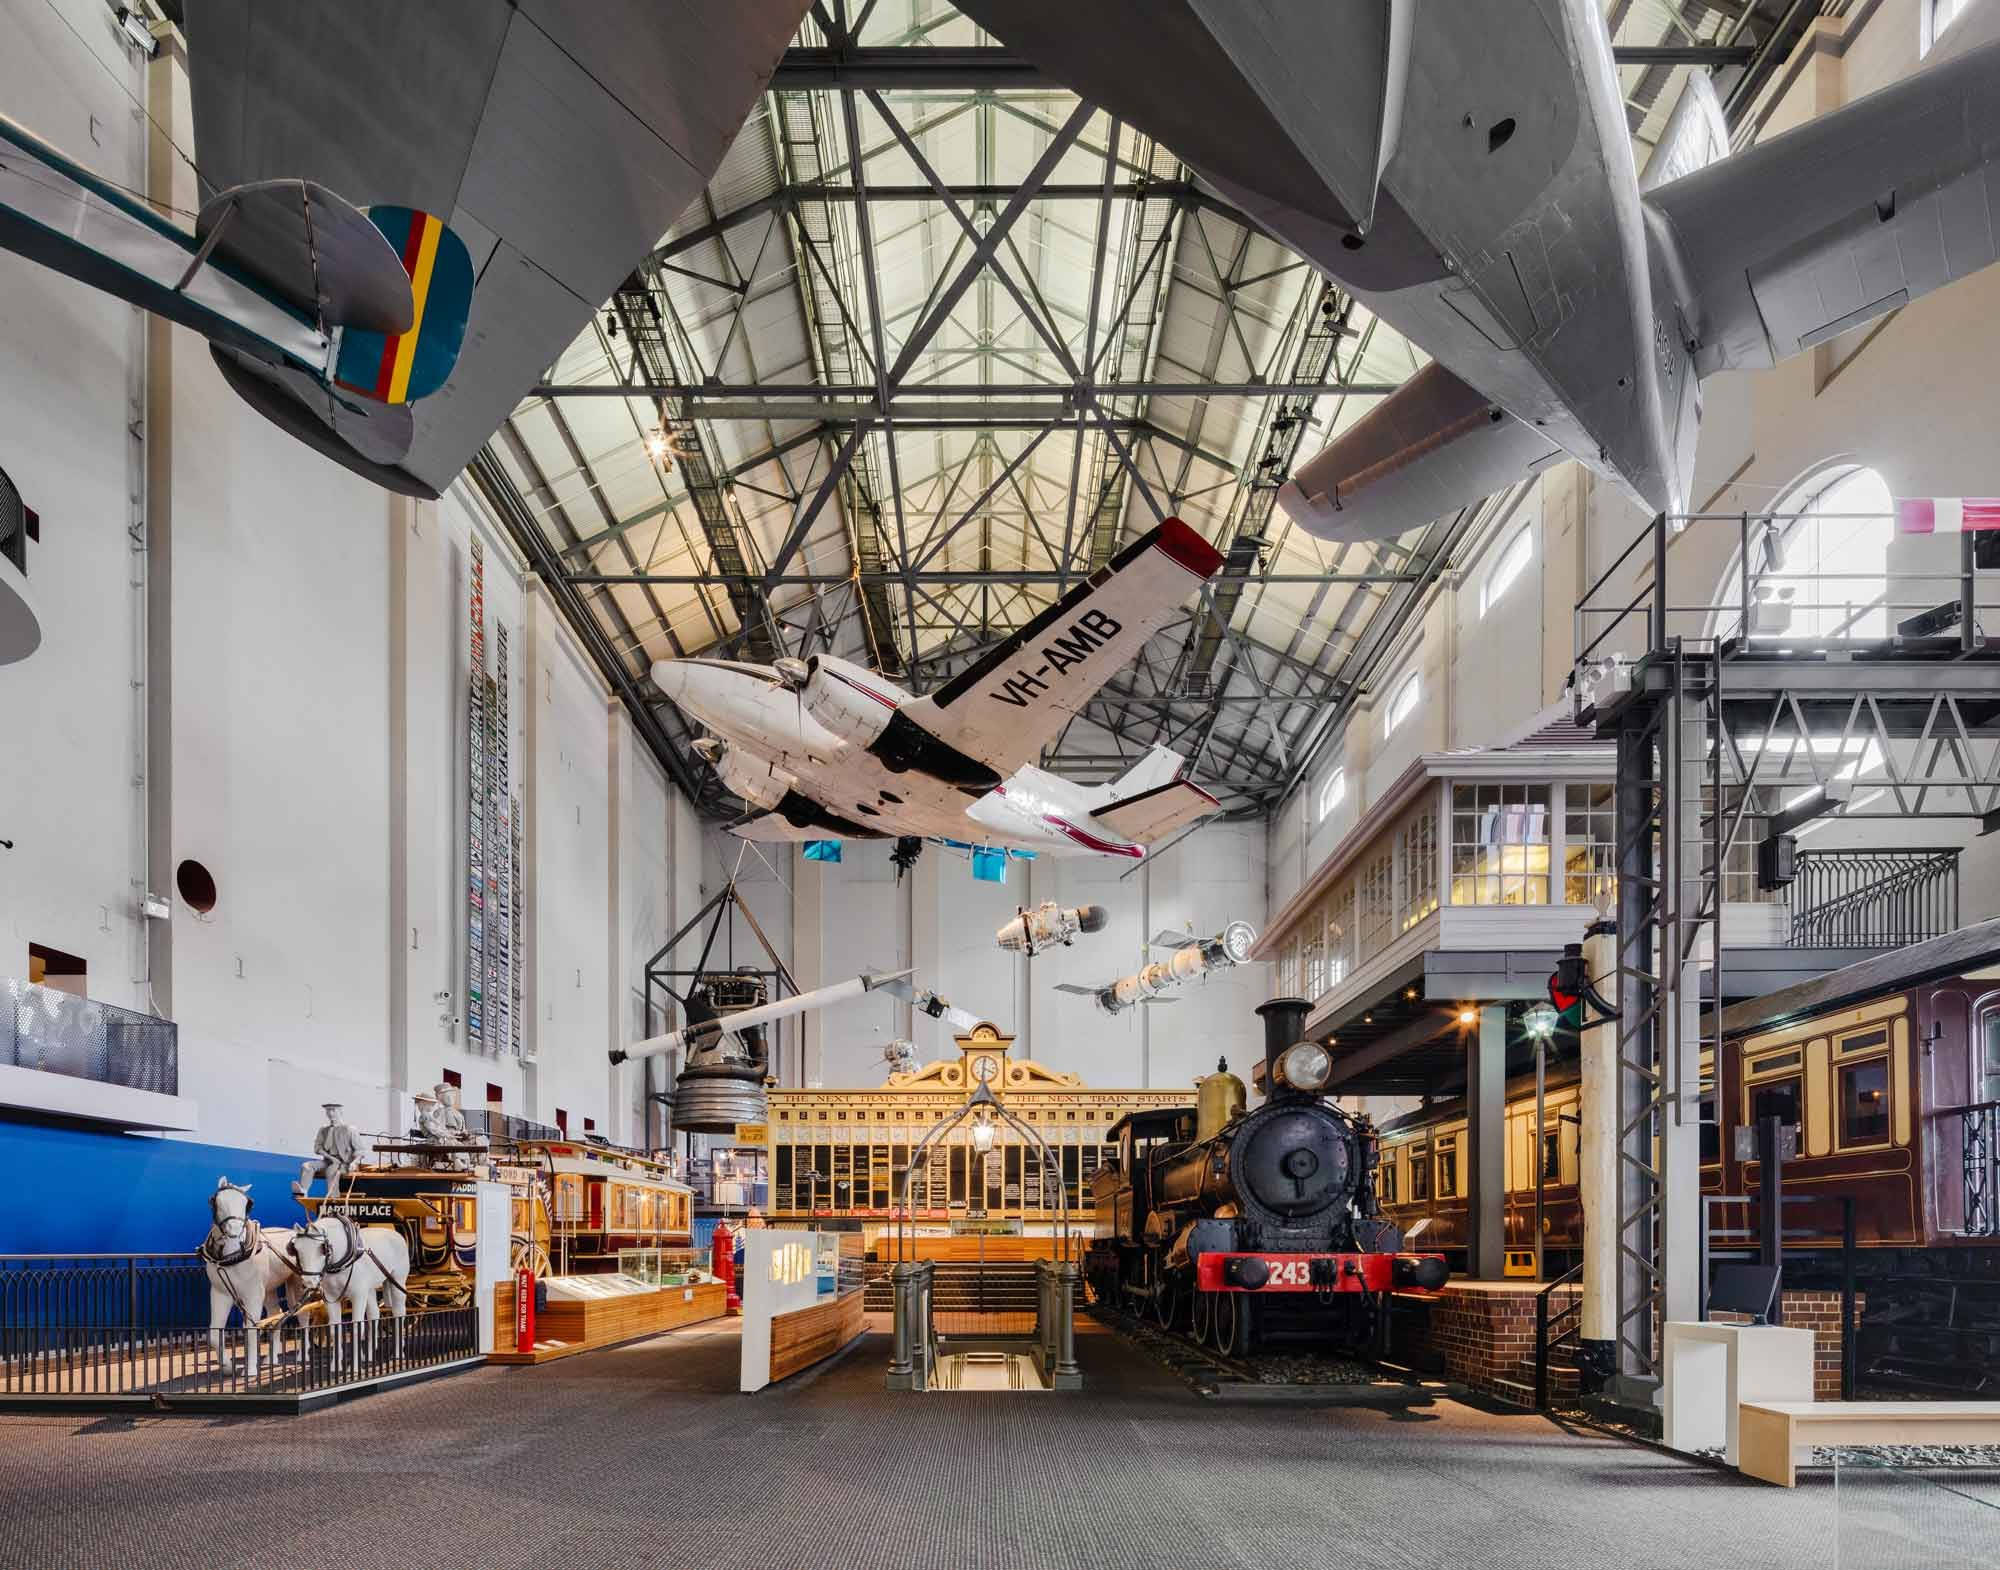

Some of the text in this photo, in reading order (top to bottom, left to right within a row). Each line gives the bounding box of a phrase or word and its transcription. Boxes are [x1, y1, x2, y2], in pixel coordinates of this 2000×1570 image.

[989, 608, 1123, 708] VH-AMB
[783, 1095, 957, 1103] THE NEXT TRAIN STARTS
[1014, 1095, 1187, 1103] THE NEXT TRAIN STARTS
[359, 1204, 392, 1216] PLACE
[1266, 1261, 1311, 1285] 243
[519, 1315, 527, 1333] TRAMS
